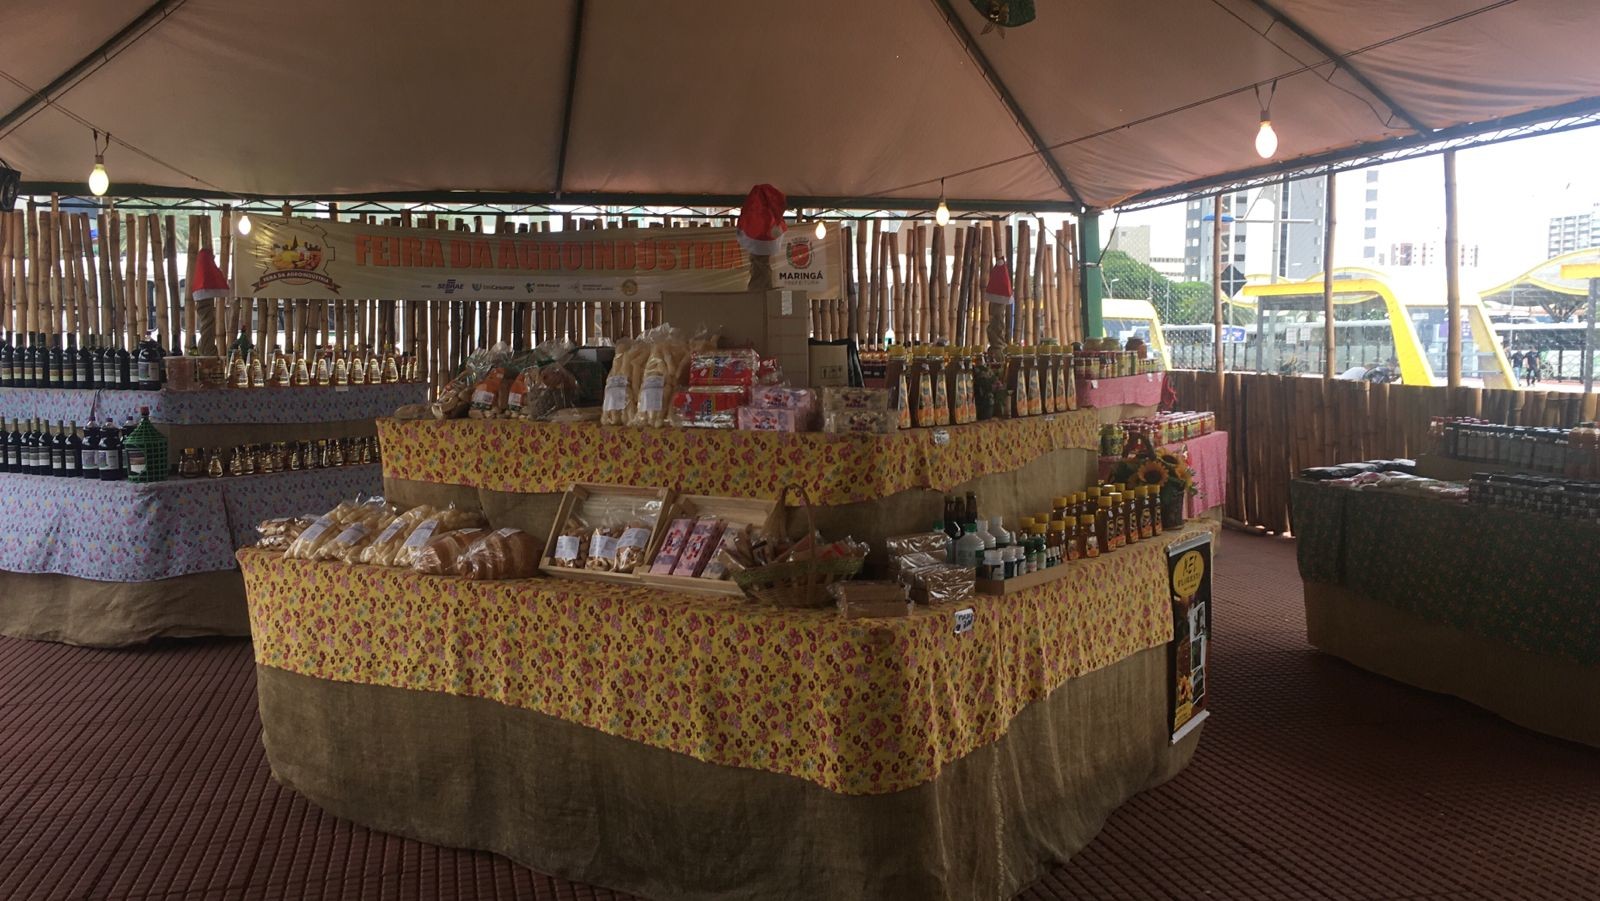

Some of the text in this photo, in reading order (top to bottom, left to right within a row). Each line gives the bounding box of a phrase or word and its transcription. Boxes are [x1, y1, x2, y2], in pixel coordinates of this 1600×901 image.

[355, 235, 745, 270] FEIRA DA AGROINDÚSTRIA
[779, 270, 823, 280] MARINGÁ
